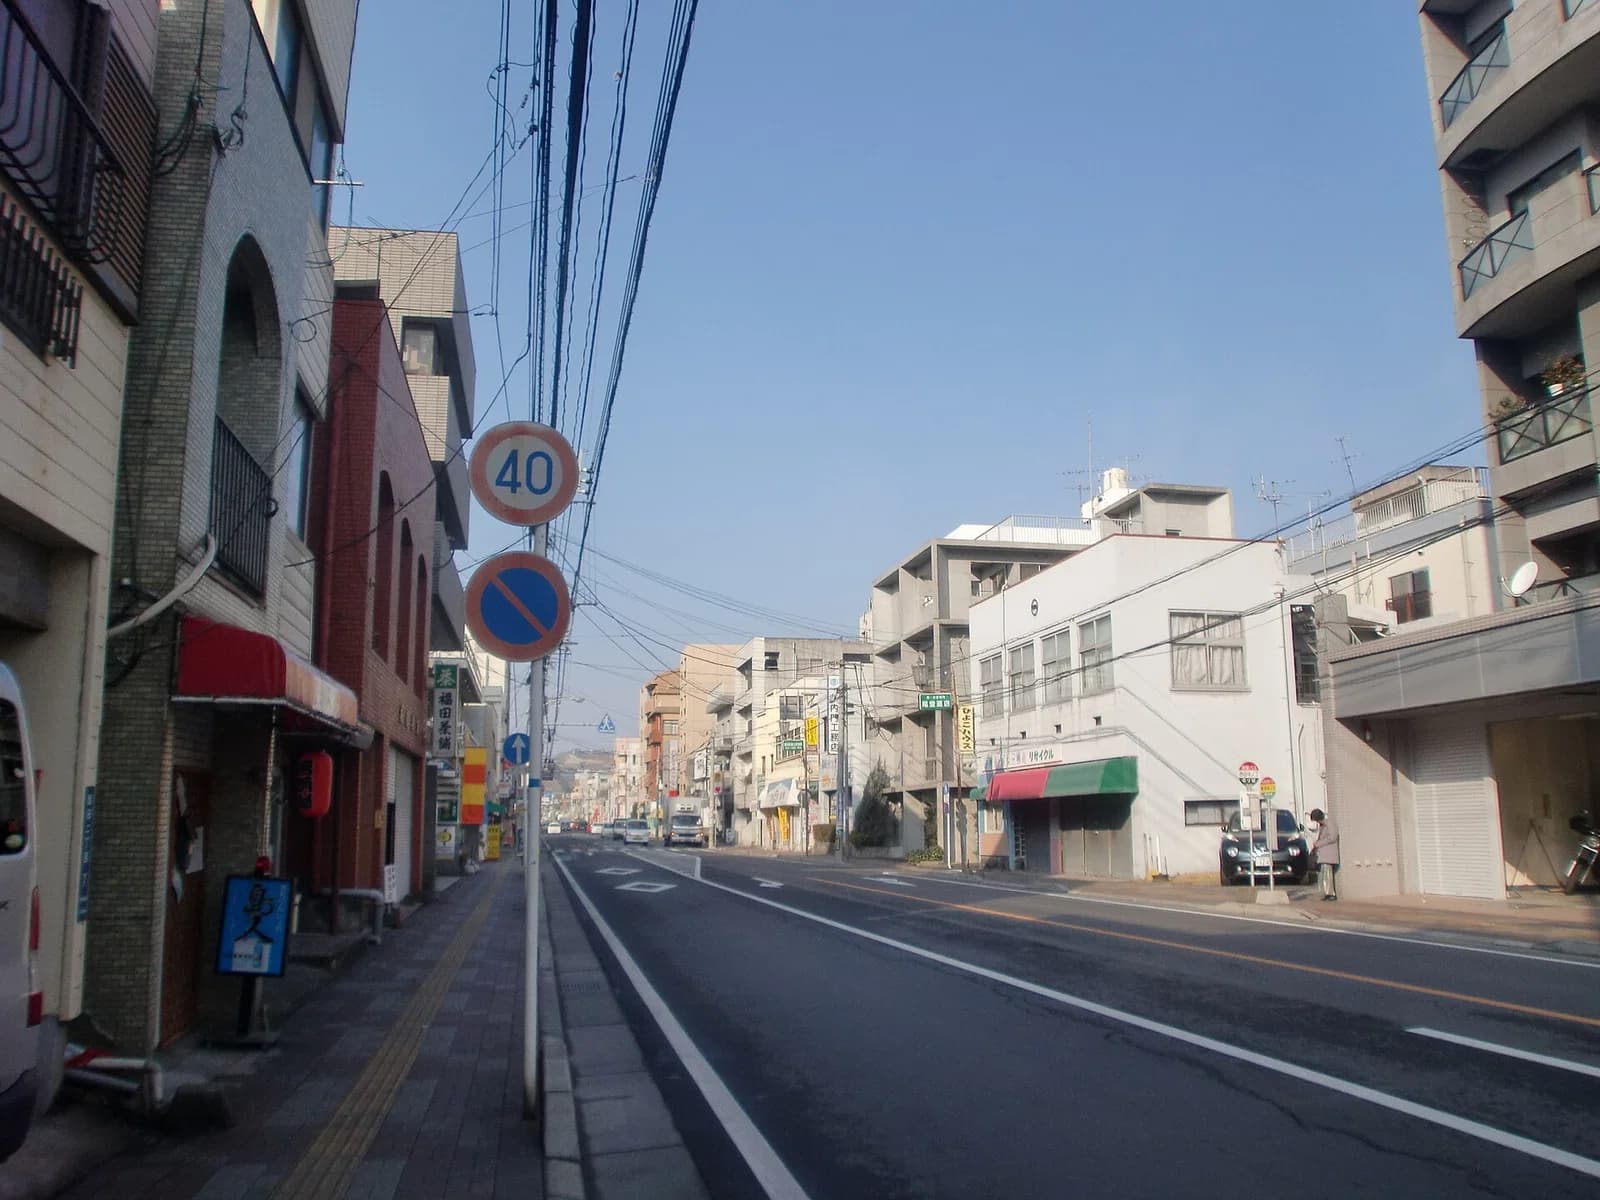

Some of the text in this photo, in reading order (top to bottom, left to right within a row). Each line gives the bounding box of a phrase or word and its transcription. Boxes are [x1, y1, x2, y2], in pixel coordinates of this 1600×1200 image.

[495, 449, 553, 495] 40
[962, 707, 971, 749] ひよこハウス
[1028, 747, 1055, 761] リサイクル
